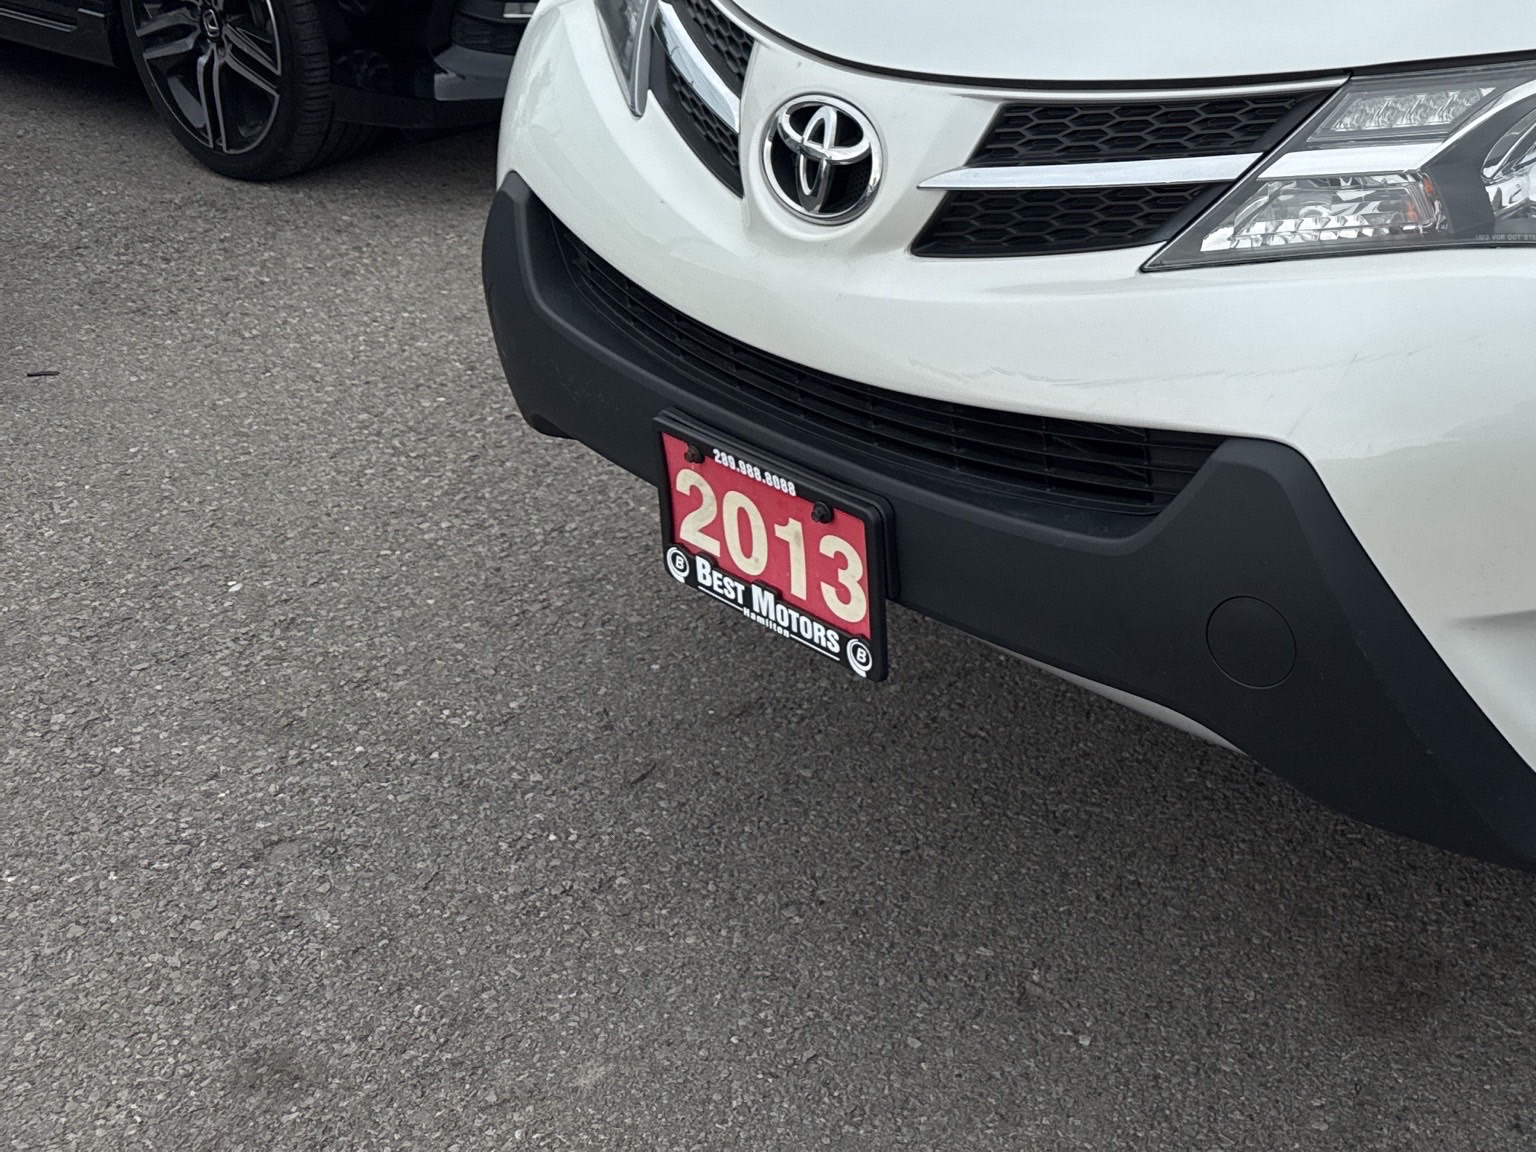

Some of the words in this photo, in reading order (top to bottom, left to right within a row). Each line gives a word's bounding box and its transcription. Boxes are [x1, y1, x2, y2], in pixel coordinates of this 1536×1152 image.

[712, 448, 797, 497] 289.988.8088
[675, 468, 867, 623] 2013
[695, 555, 746, 605] BEST
[751, 583, 841, 654] MOTORS
[743, 607, 791, 639] Hamilton
